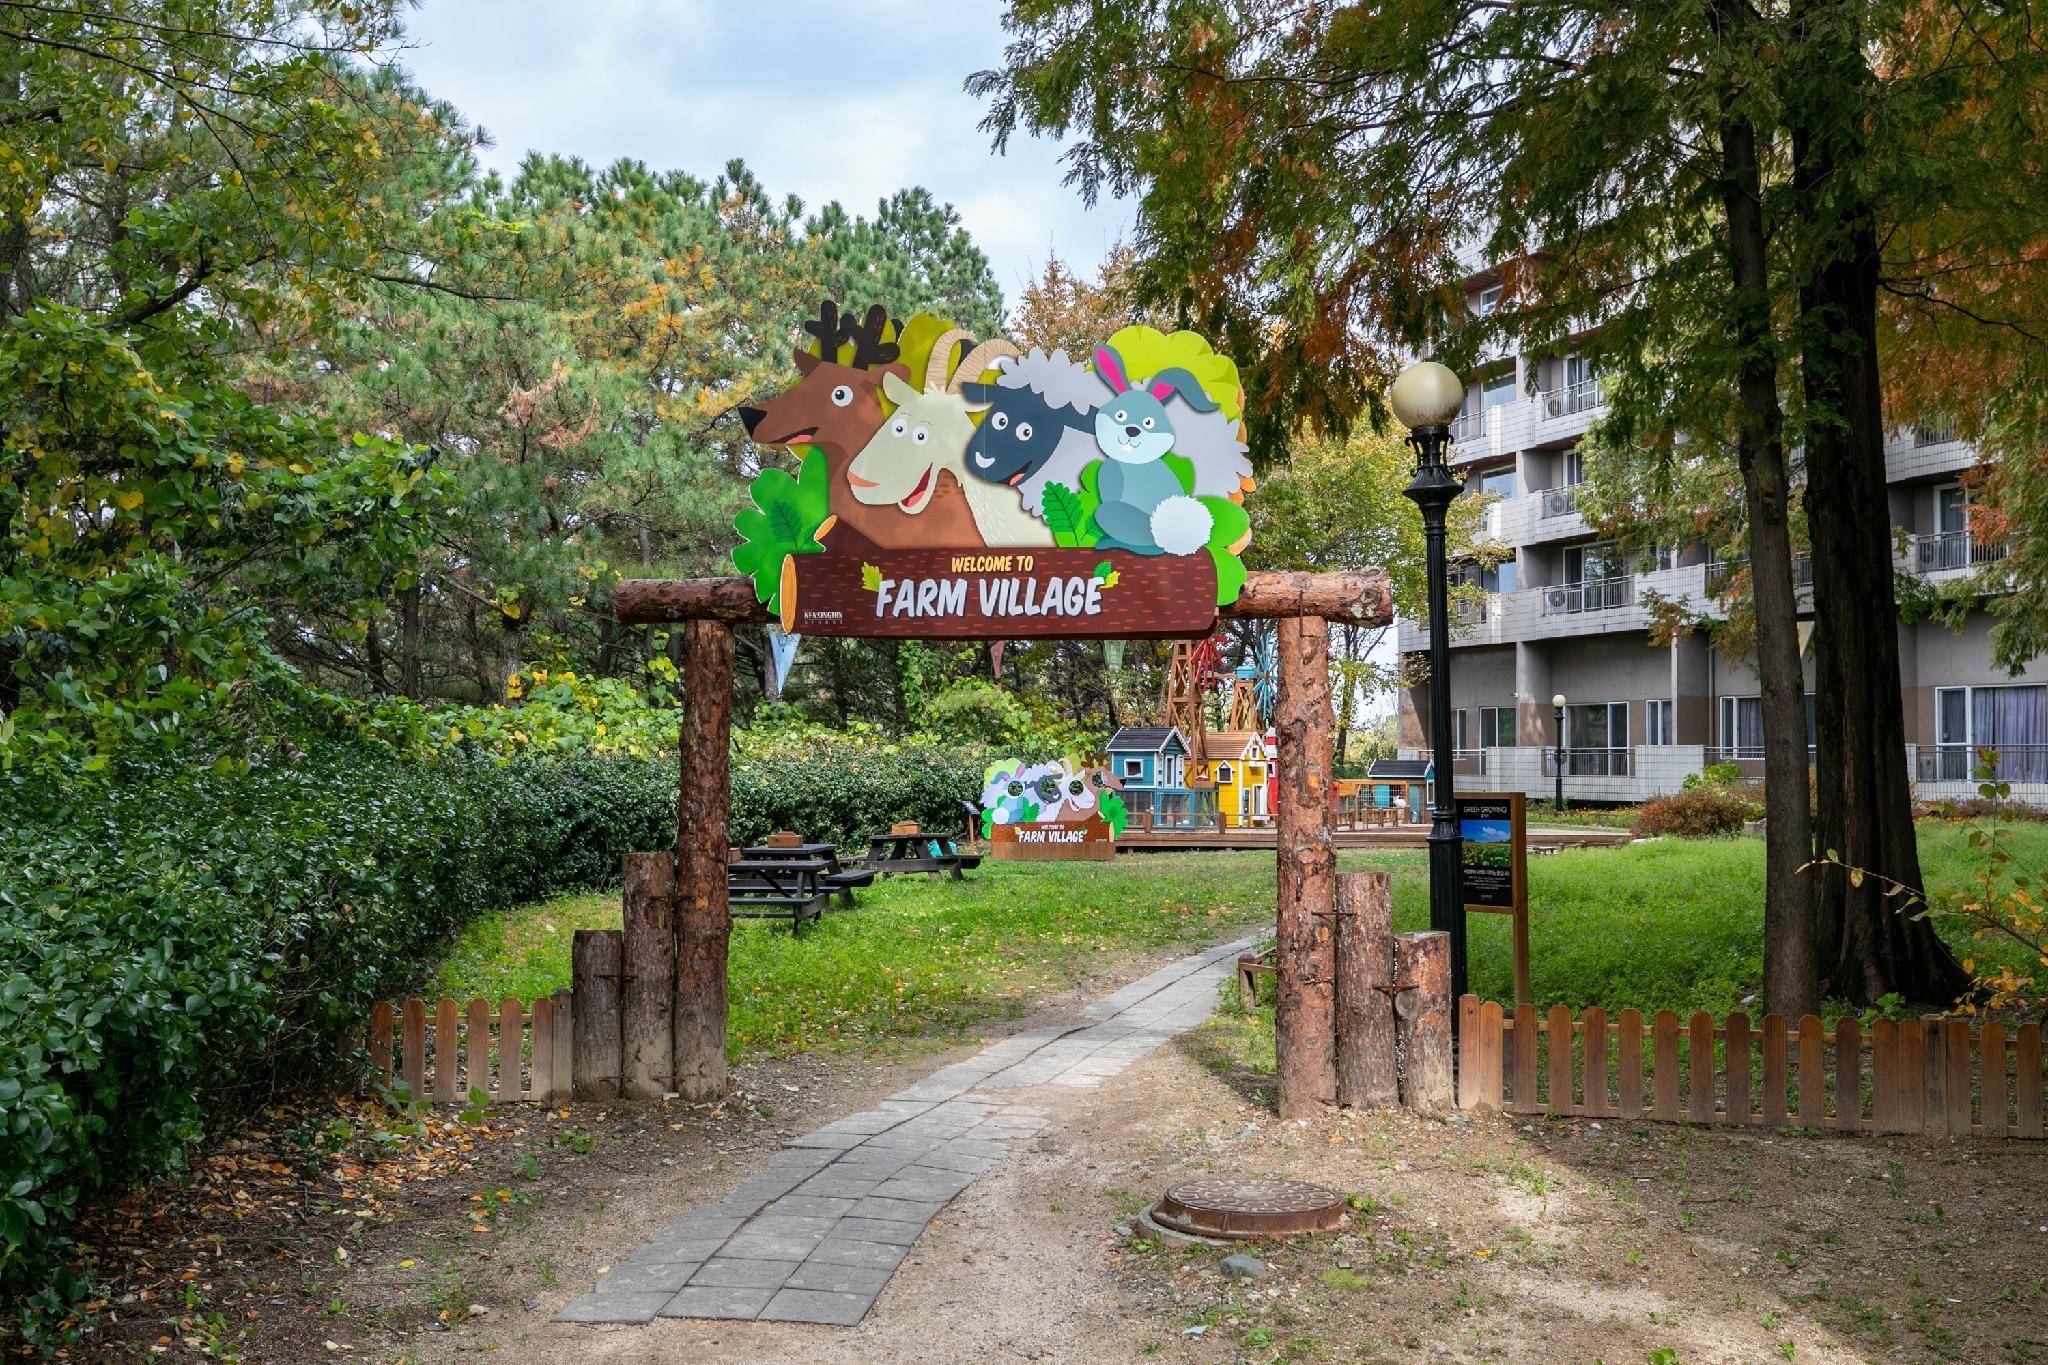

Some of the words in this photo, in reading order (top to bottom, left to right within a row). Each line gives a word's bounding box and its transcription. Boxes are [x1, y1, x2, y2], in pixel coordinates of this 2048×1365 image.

[951, 556, 1012, 573] WELCOME
[1015, 556, 1034, 572] TO
[875, 578, 968, 617] FARM
[979, 576, 1107, 616] VILLAGE
[804, 611, 843, 619] KENSINGTON
[1481, 806, 1507, 814] GROWING
[1018, 831, 1045, 842] FARM
[1048, 831, 1084, 842] VILLAGE
